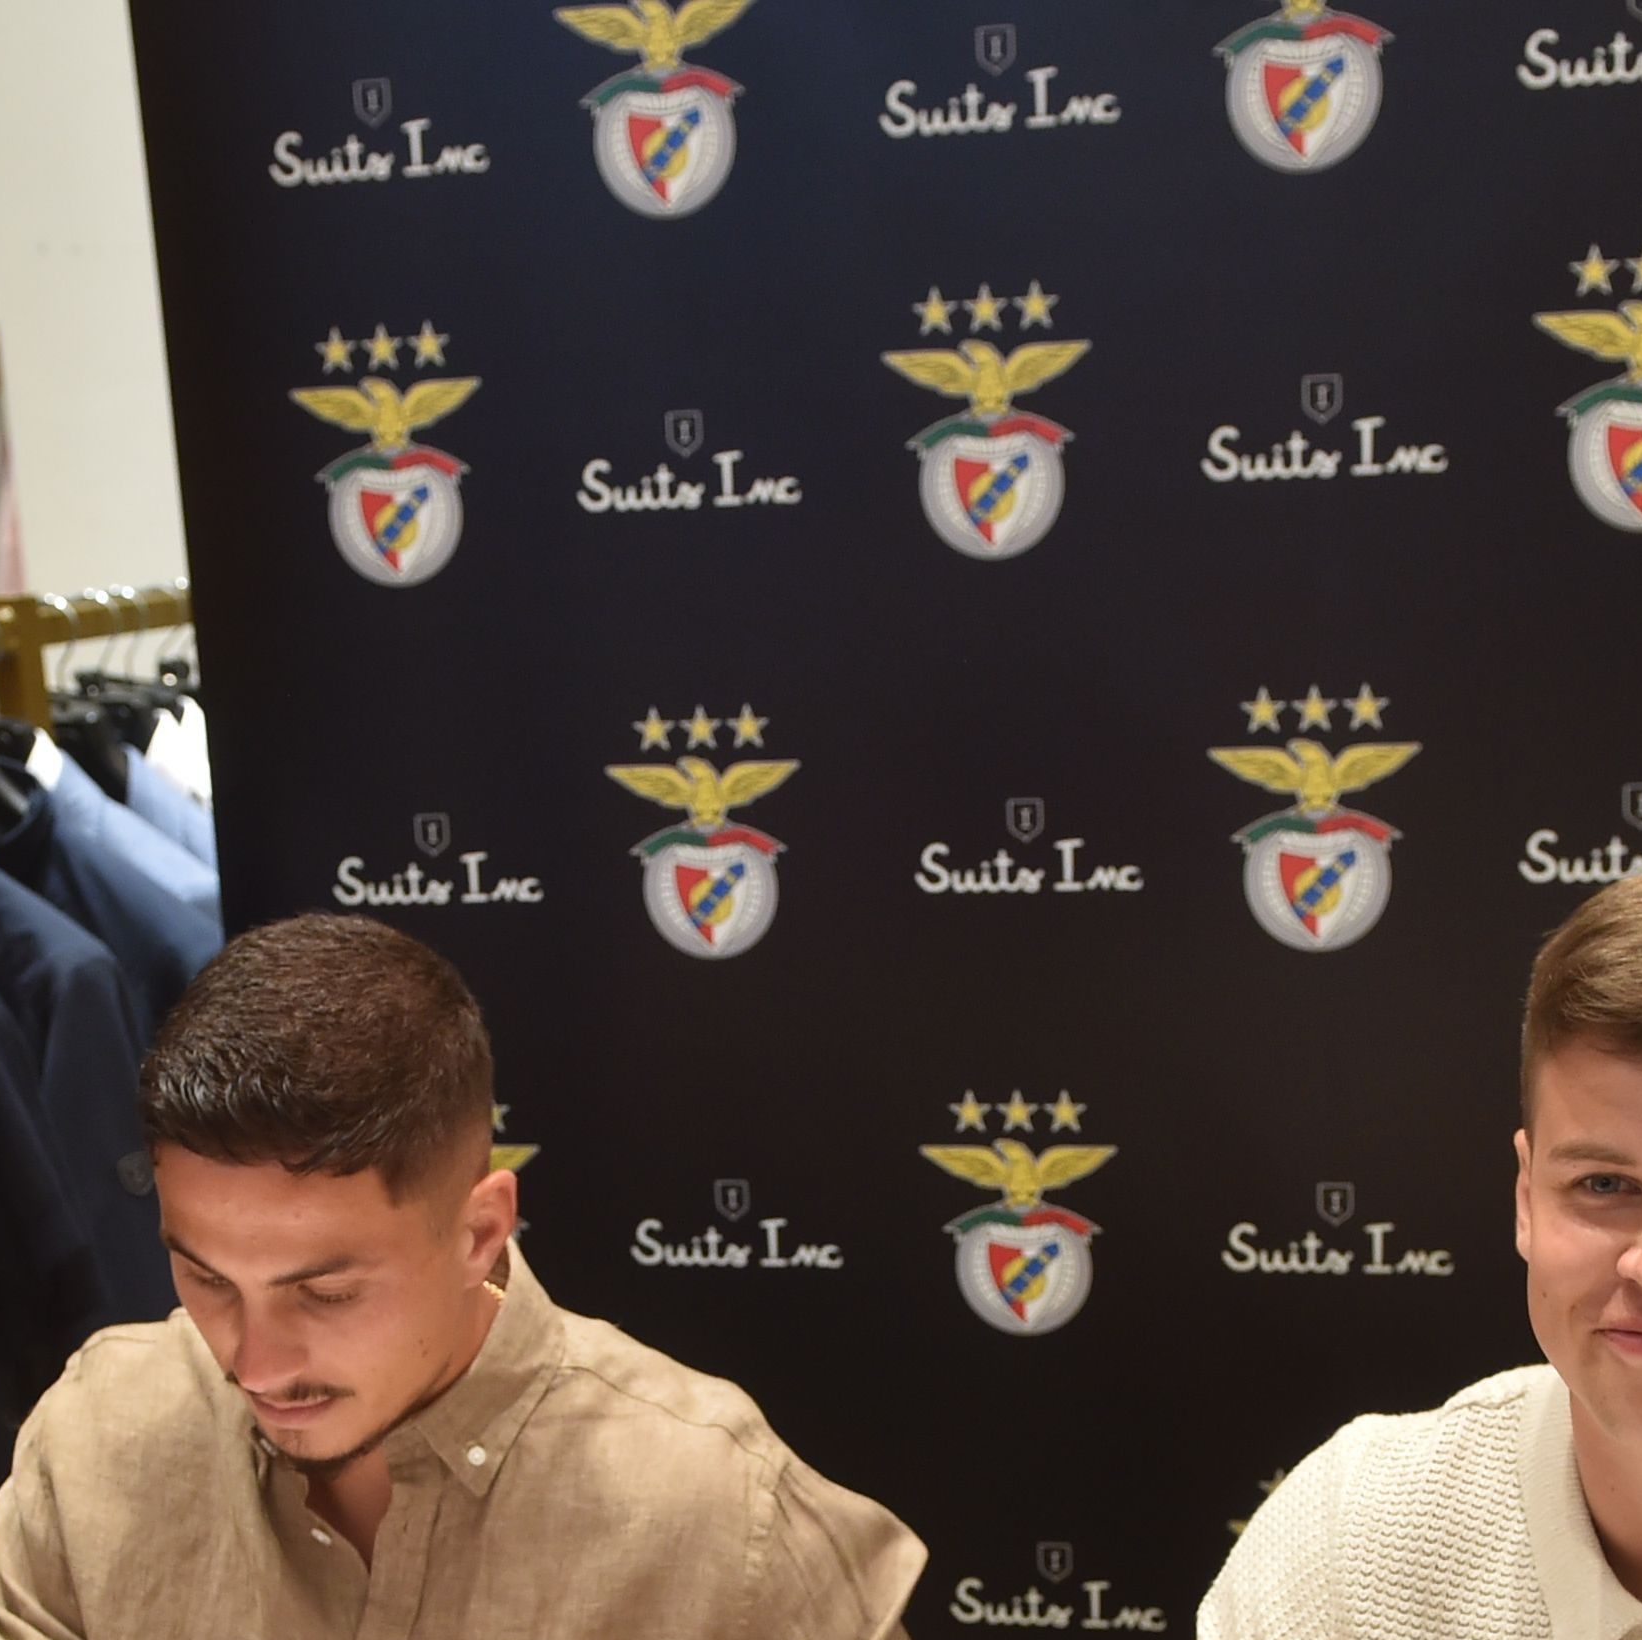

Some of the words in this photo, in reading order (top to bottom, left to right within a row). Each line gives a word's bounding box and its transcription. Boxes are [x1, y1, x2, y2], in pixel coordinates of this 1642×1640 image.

[880, 79, 1017, 138] Suits
[1026, 66, 1121, 129] Inc
[269, 131, 394, 187] Suits
[401, 118, 490, 178] Inc
[1201, 425, 1342, 482] Suits
[1351, 416, 1449, 476] Inc
[576, 458, 706, 513] Suits
[713, 449, 802, 507] Inc
[332, 856, 453, 906] Suits
[460, 851, 544, 904] Inc
[914, 842, 1045, 894] Suits
[1053, 837, 1144, 892] Inc
[630, 1218, 752, 1268] Suits
[759, 1217, 844, 1269] Inc
[1221, 1222, 1354, 1275] Suits
[1363, 1222, 1454, 1276] Inc
[949, 1577, 1074, 1629] Suits
[1082, 1580, 1167, 1632] Inc
